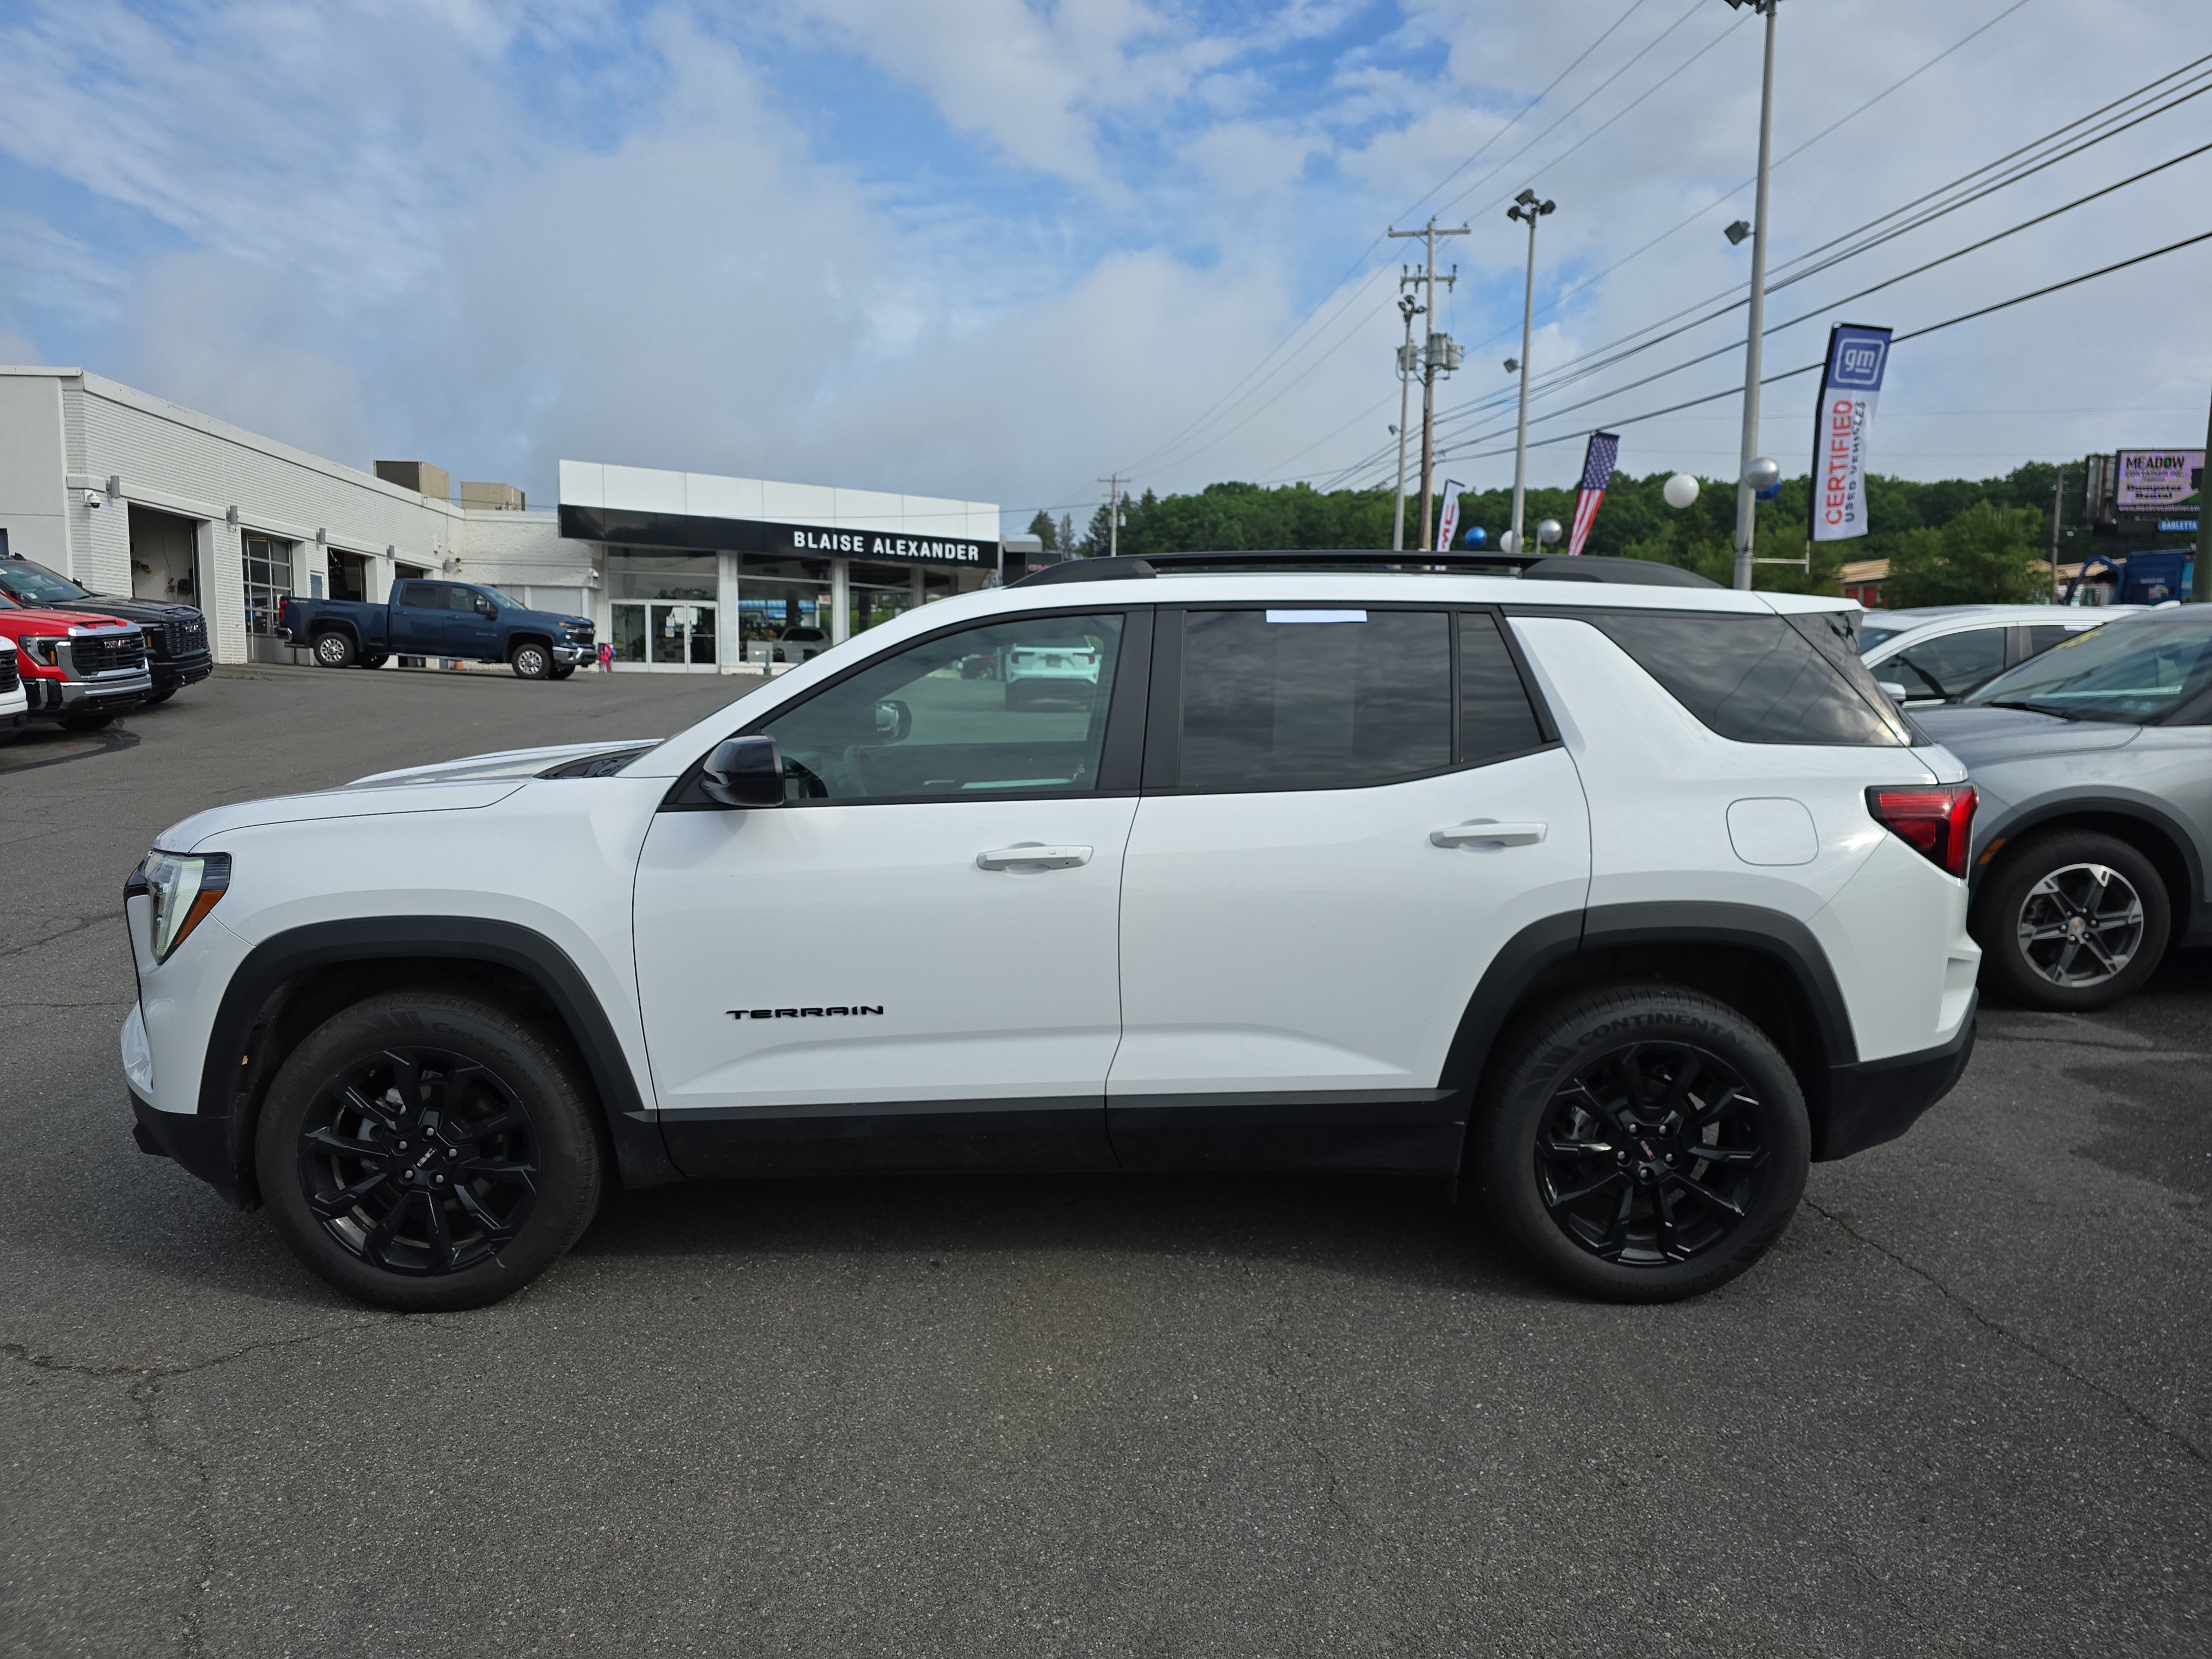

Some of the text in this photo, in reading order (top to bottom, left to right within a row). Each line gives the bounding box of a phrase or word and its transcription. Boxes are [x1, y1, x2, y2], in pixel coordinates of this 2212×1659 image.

[1844, 349, 1875, 374] gm
[1825, 399, 1853, 525] CERTIFIED
[1844, 400, 1866, 523] USED VEHICLES
[2126, 456, 2184, 468] MEADOW
[794, 530, 979, 561] BLAISE ALEXANDER
[726, 1006, 884, 1020] TERRAIN
[1578, 1013, 1747, 1051] CONTINENTAL
